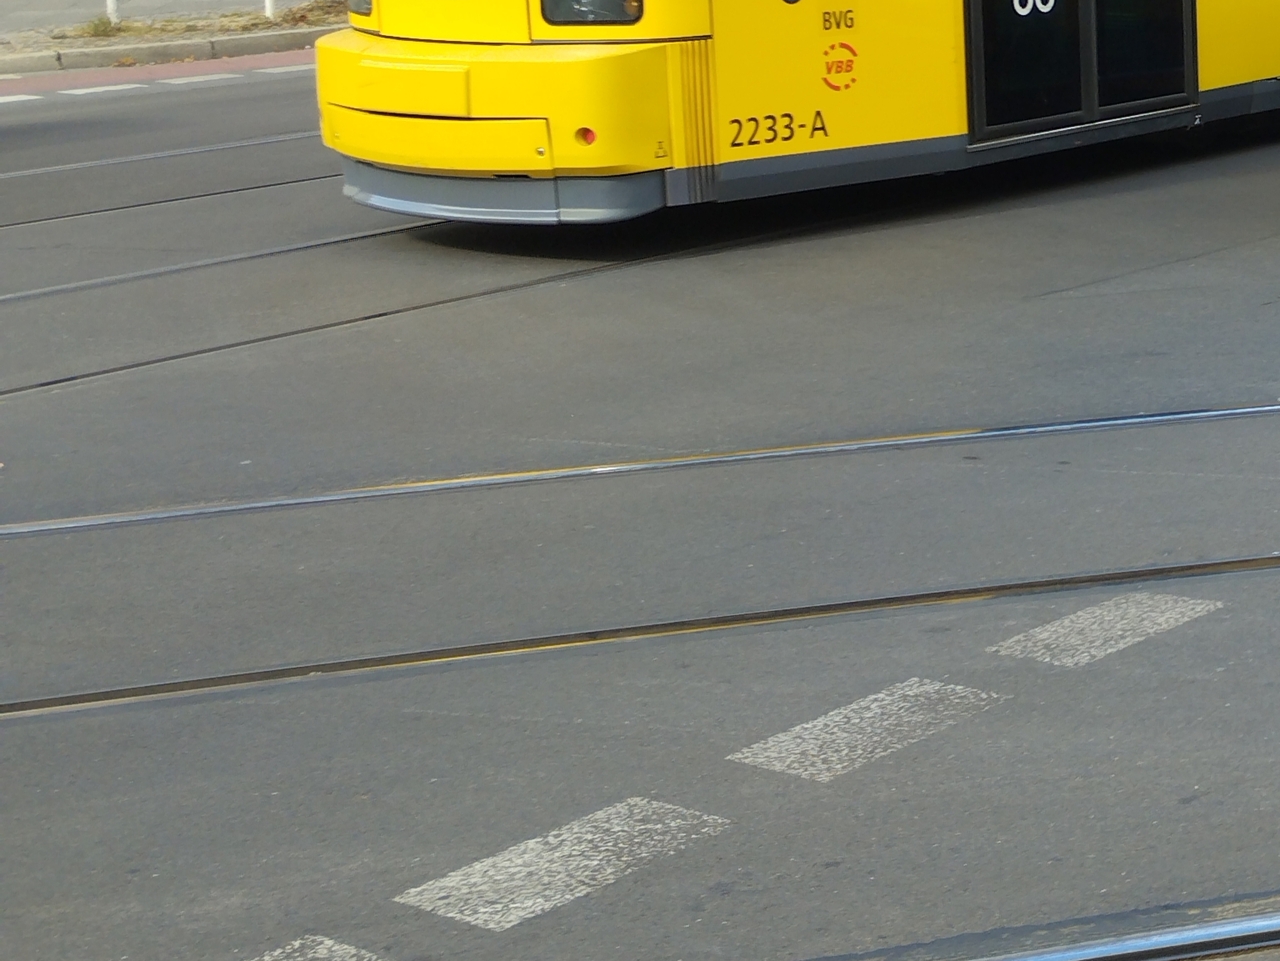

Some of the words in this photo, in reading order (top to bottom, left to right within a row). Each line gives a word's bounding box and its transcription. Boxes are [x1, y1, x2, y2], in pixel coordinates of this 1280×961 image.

[822, 10, 855, 31] BVG
[824, 59, 855, 75] VBB
[728, 110, 829, 148] 2233-A
